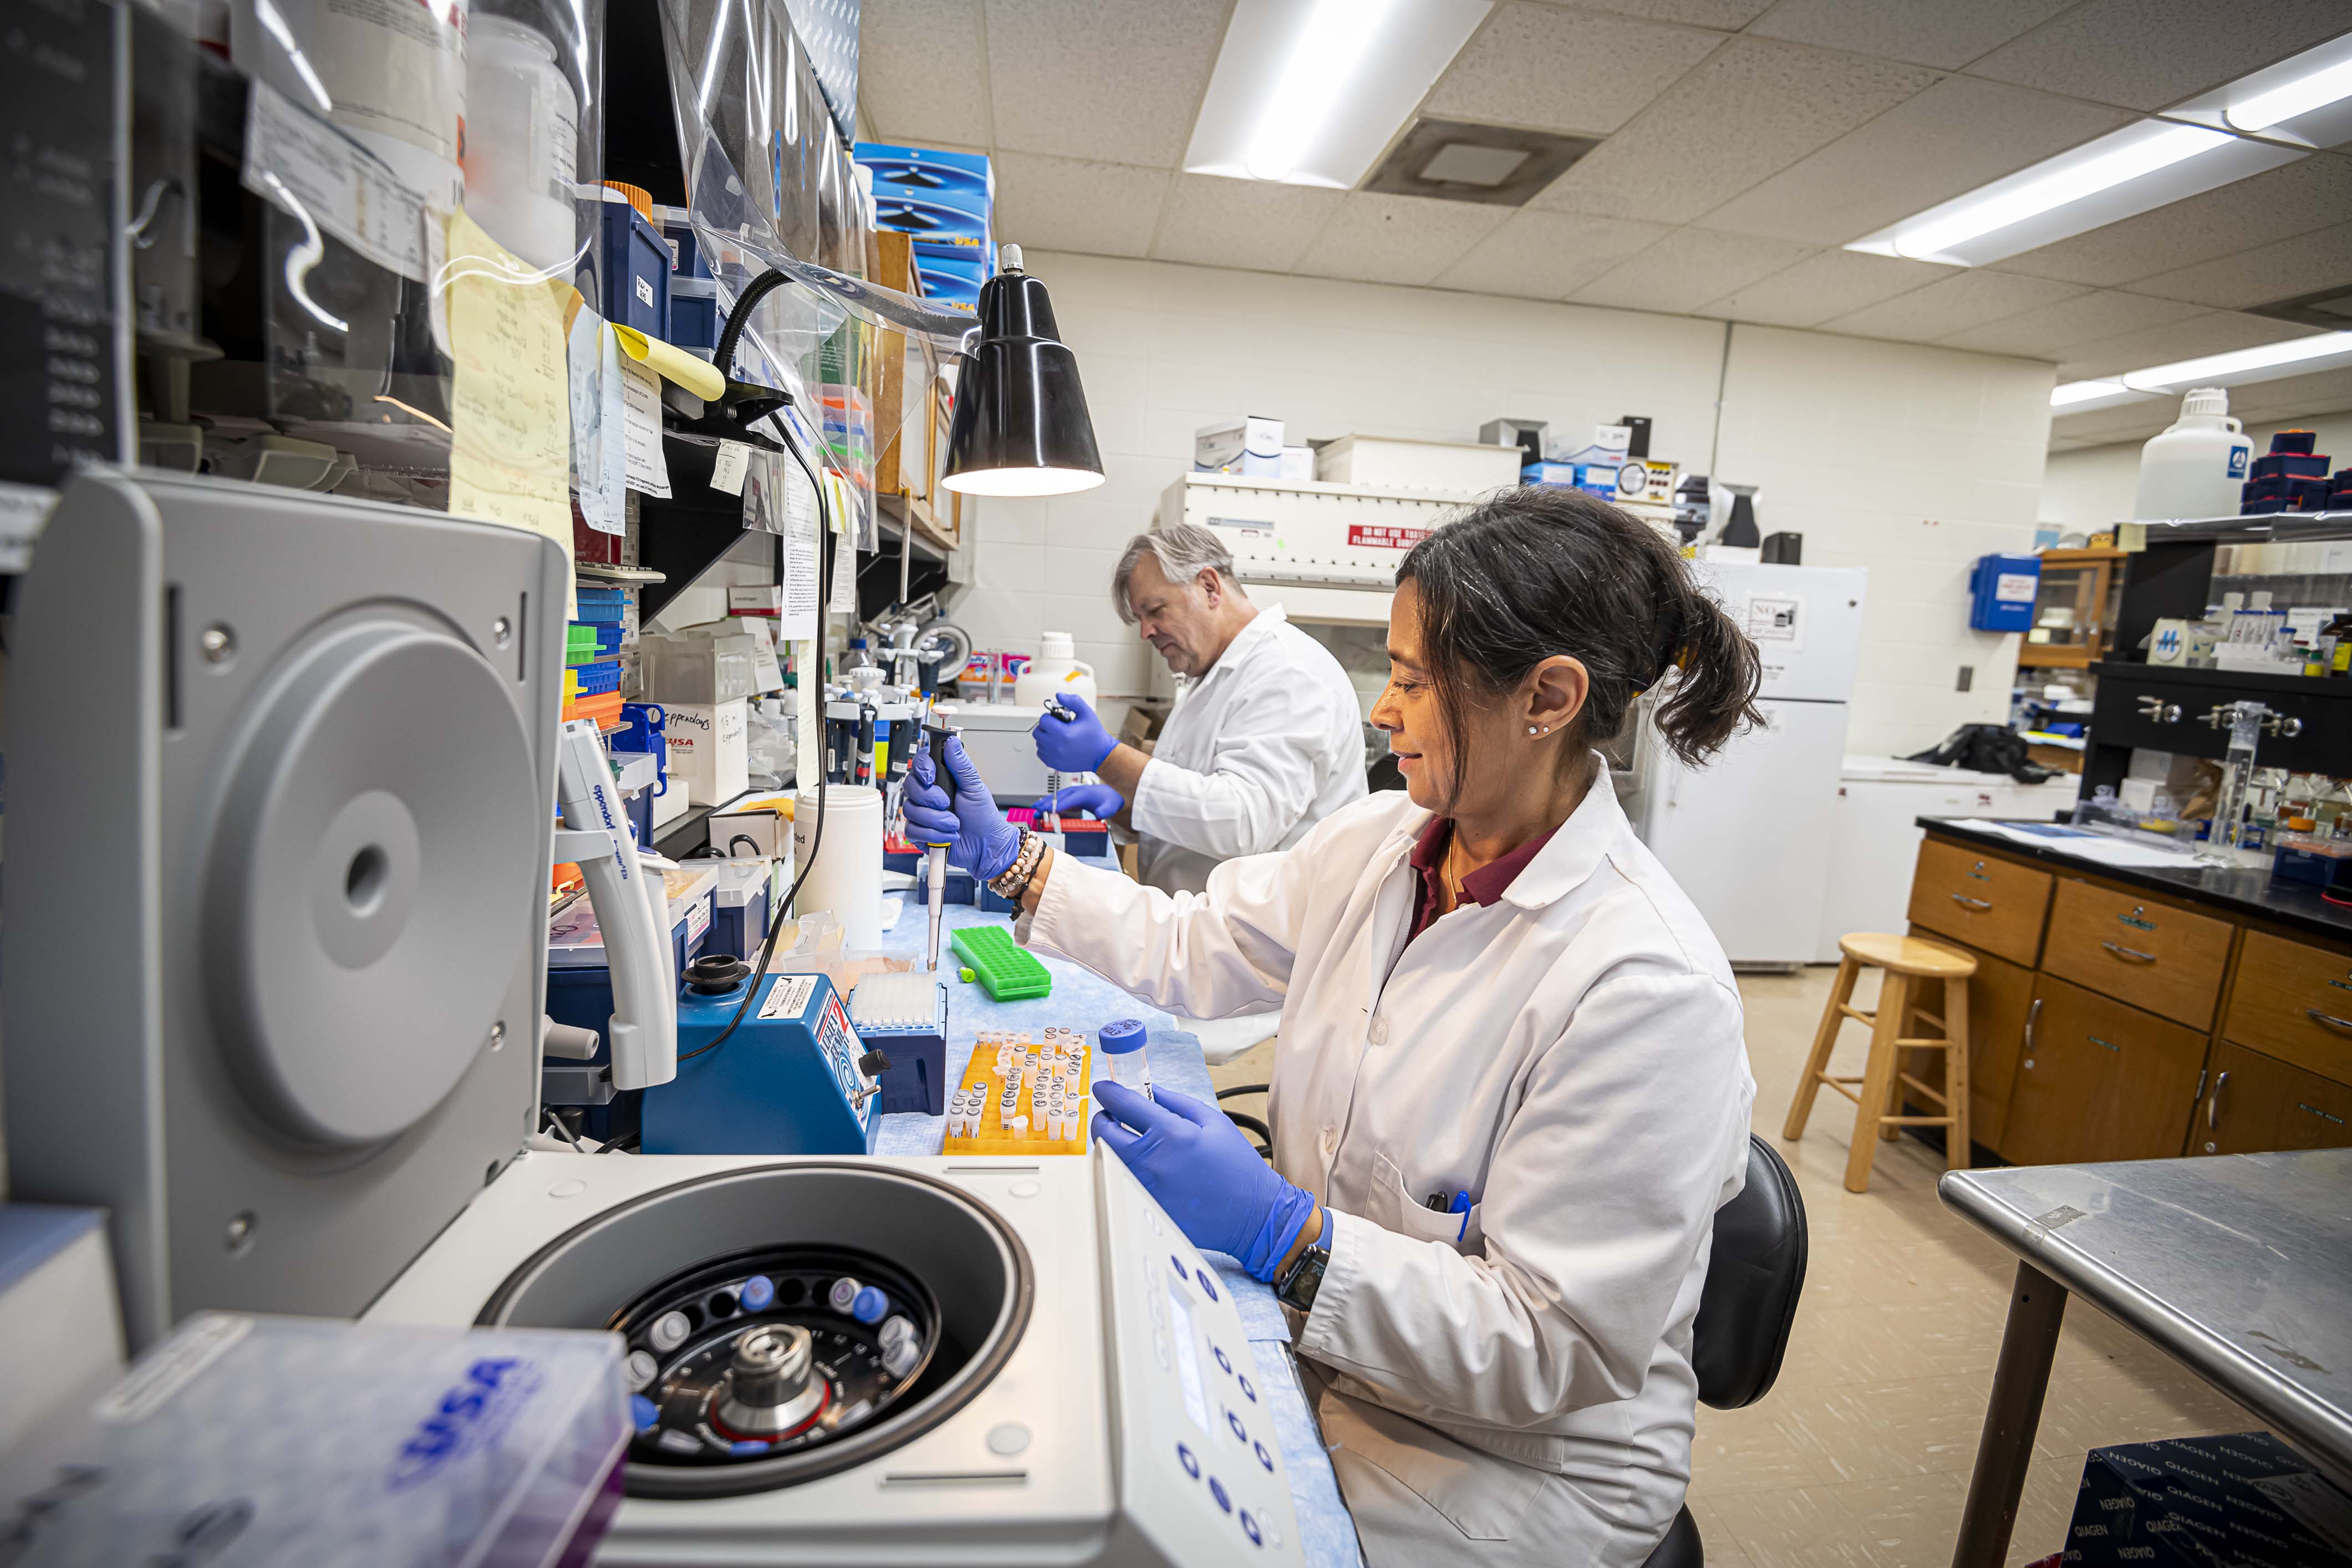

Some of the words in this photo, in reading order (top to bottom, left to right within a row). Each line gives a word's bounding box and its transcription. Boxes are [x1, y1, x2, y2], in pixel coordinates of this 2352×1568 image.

[955, 236, 980, 247] USA
[1352, 534, 1394, 547] FLAMMABLE
[1362, 527, 1373, 536] DO
[1373, 528, 1387, 537] NOT
[1389, 529, 1402, 538] USE
[593, 784, 617, 829] eppendorf
[833, 1000, 849, 1034] 2
[396, 1356, 517, 1461] USA
[2109, 1451, 2162, 1475] QIAGEN
[2220, 1445, 2273, 1469] QIAGEN
[2165, 1460, 2219, 1486] QIAGEN
[2099, 1496, 2135, 1510] QIAGEN
[2167, 1485, 2223, 1512] QIAGEN
[2226, 1495, 2284, 1521] QIAGEN
[2075, 1524, 2108, 1537] QIAGEN
[2168, 1512, 2226, 1539] QIAGEN
[2117, 1546, 2155, 1559] QIAGEN
